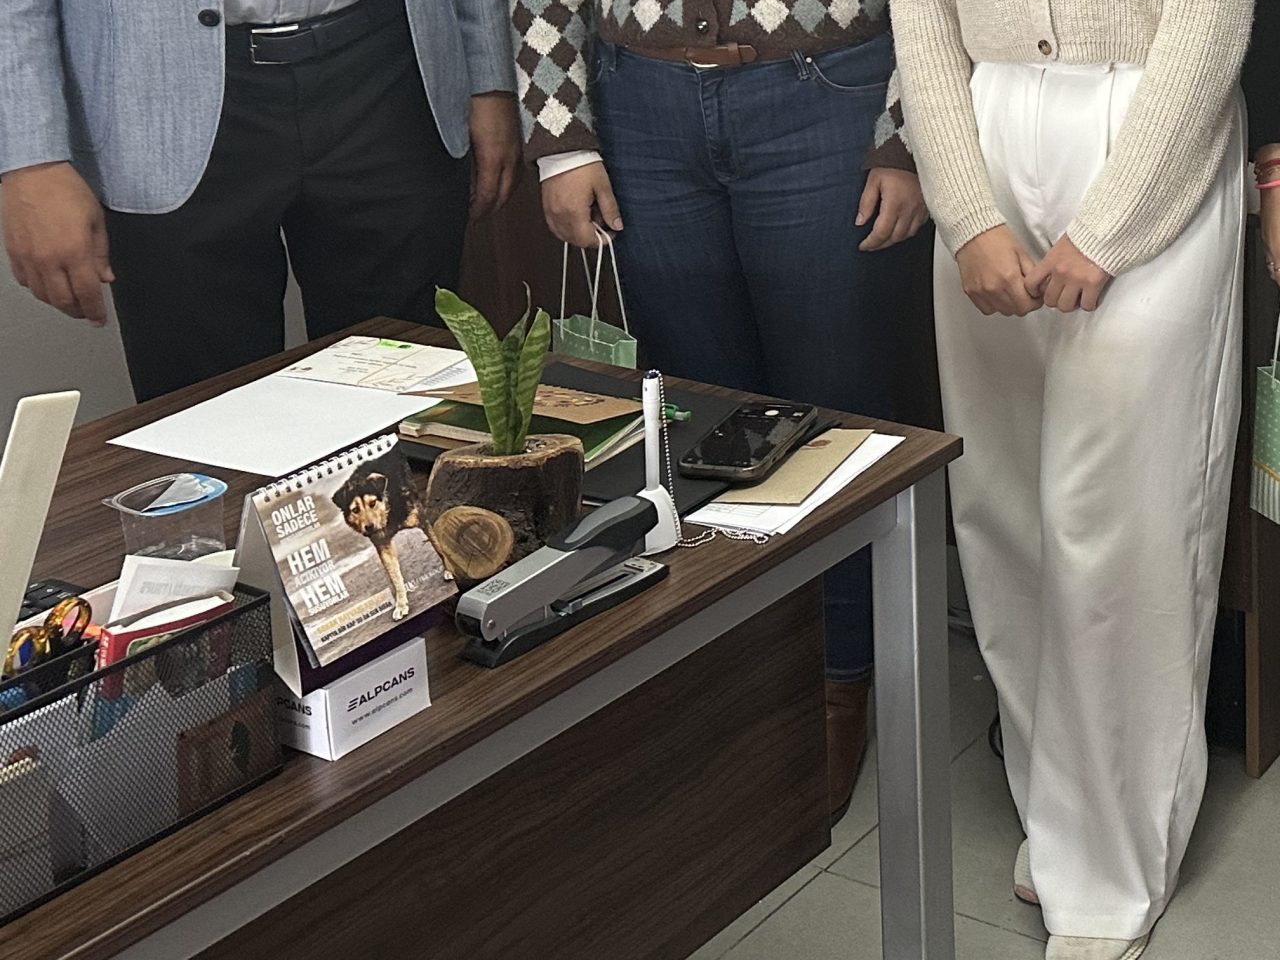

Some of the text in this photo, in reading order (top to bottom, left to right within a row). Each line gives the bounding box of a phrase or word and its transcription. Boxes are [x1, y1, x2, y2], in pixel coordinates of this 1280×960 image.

[271, 495, 316, 526] ONLAR
[275, 509, 319, 538] SADECE
[287, 538, 331, 576] HEM
[300, 572, 347, 608] HEM
[358, 667, 415, 707] ALPCANS
[351, 688, 413, 725] www.alpcans.com
